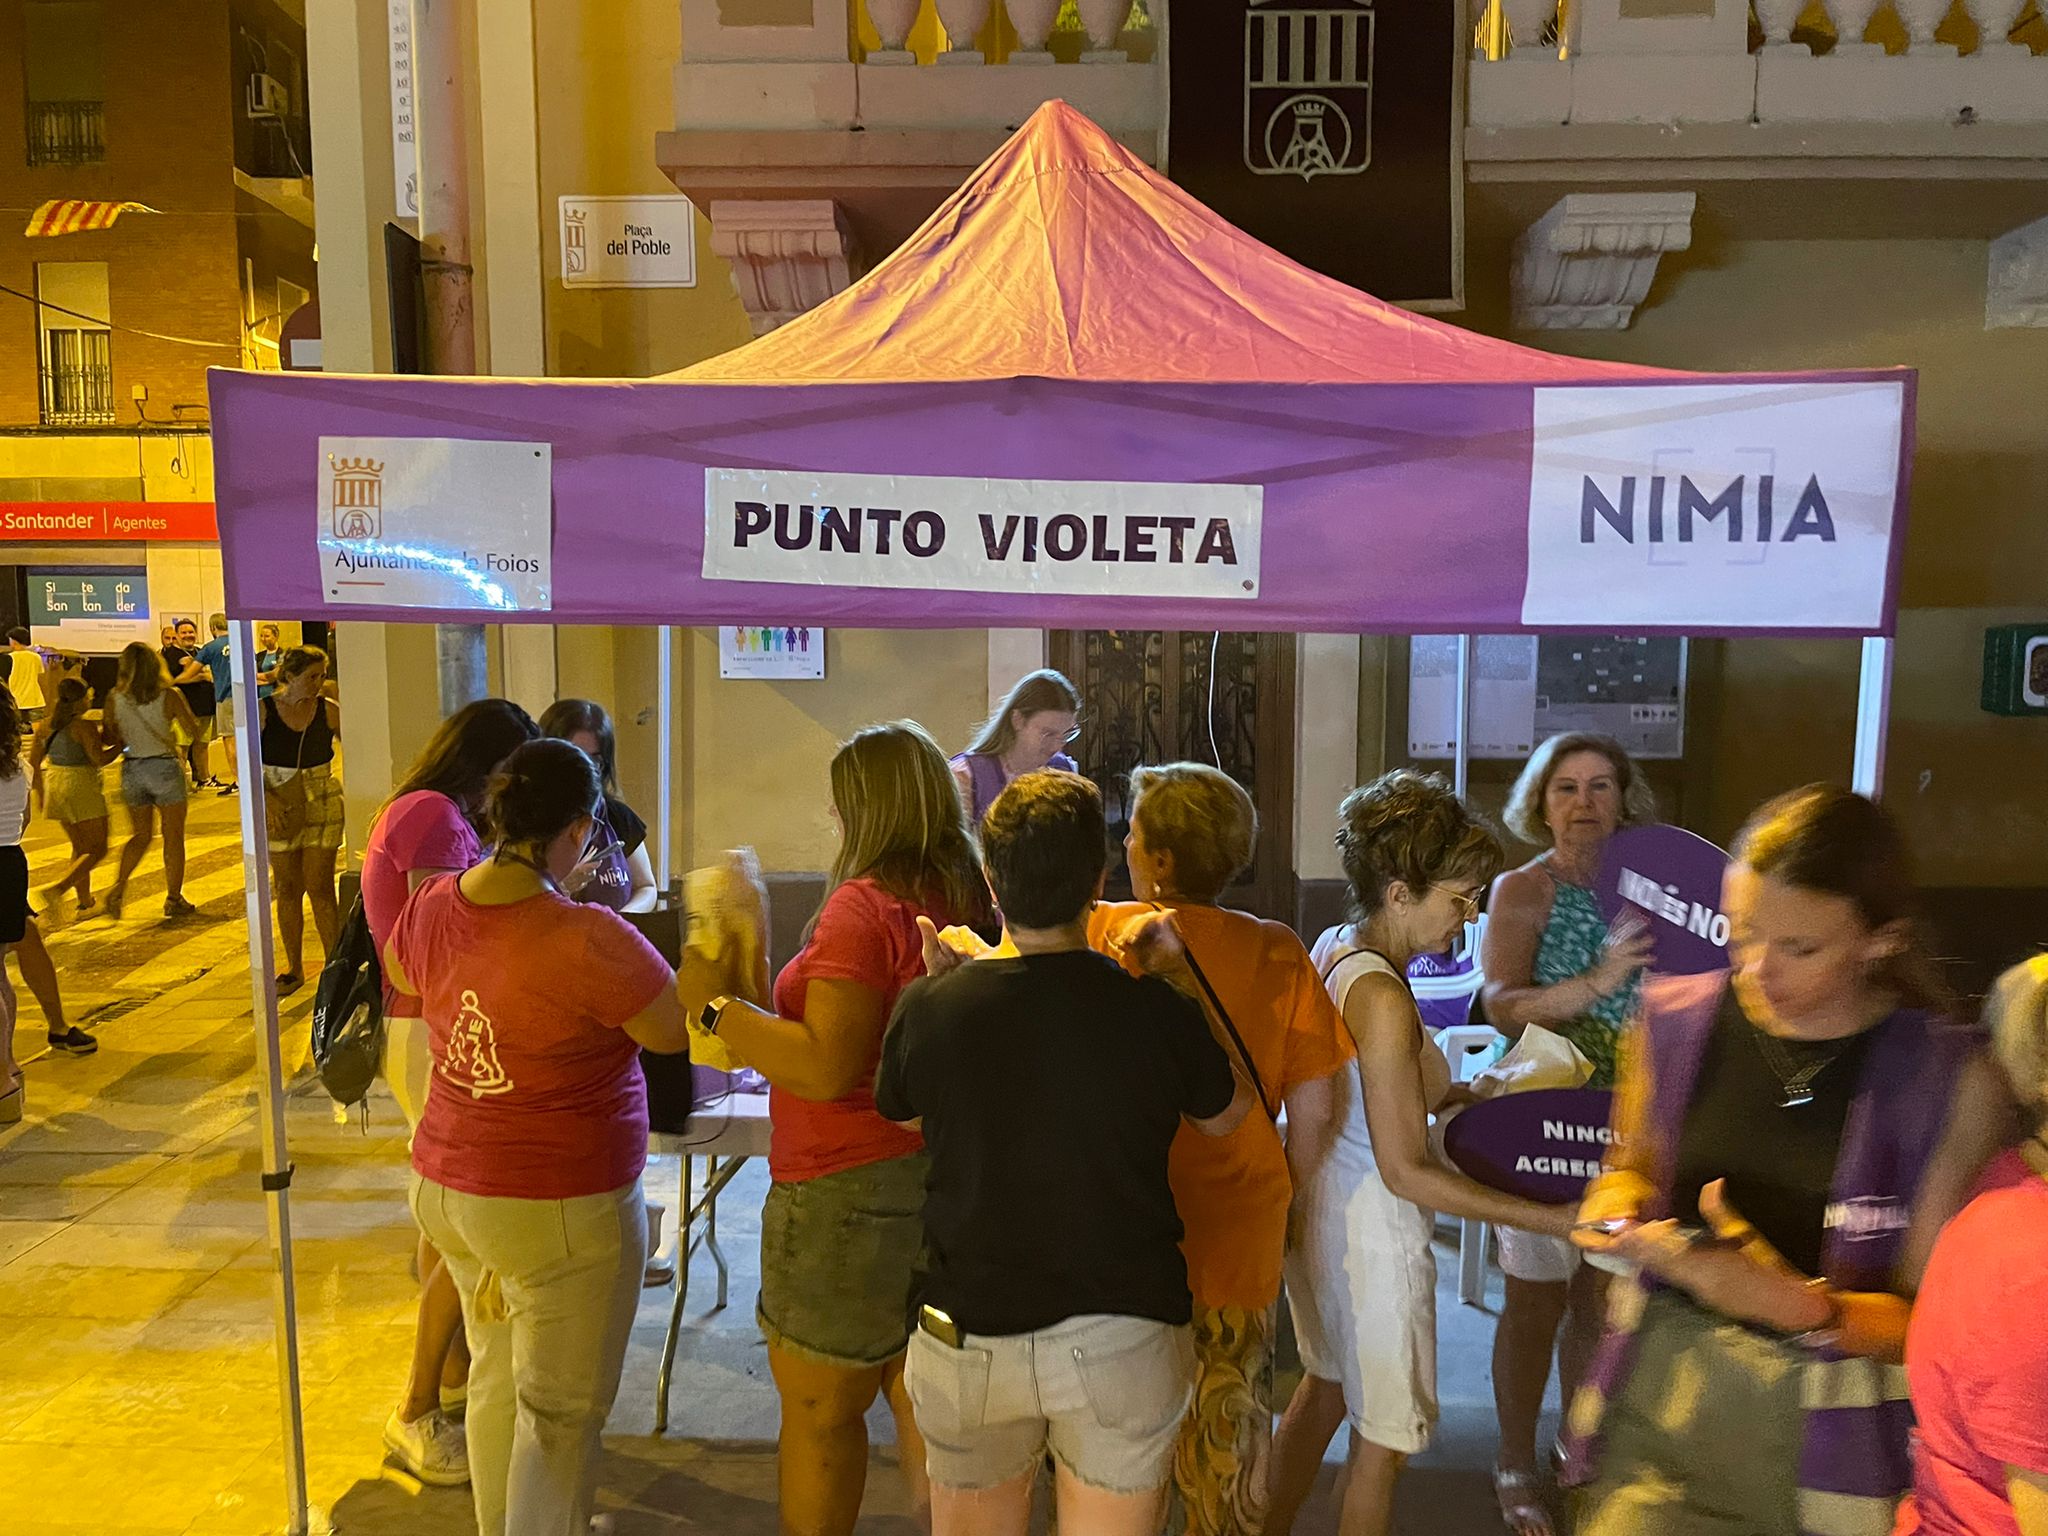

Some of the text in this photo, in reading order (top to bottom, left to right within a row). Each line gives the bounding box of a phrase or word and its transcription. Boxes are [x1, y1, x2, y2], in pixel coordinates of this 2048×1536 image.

[624, 224, 653, 238] Plaça
[607, 240, 671, 255] del Poble
[1580, 472, 1836, 544] NIMIA
[5, 513, 167, 532] Santander Agentes
[732, 501, 1238, 566] PUNTO VIOLETA
[487, 552, 539, 573] Foios
[45, 582, 130, 592] Si te da
[46, 600, 68, 611] San
[116, 600, 136, 612] der
[1686, 901, 1732, 947] NO
